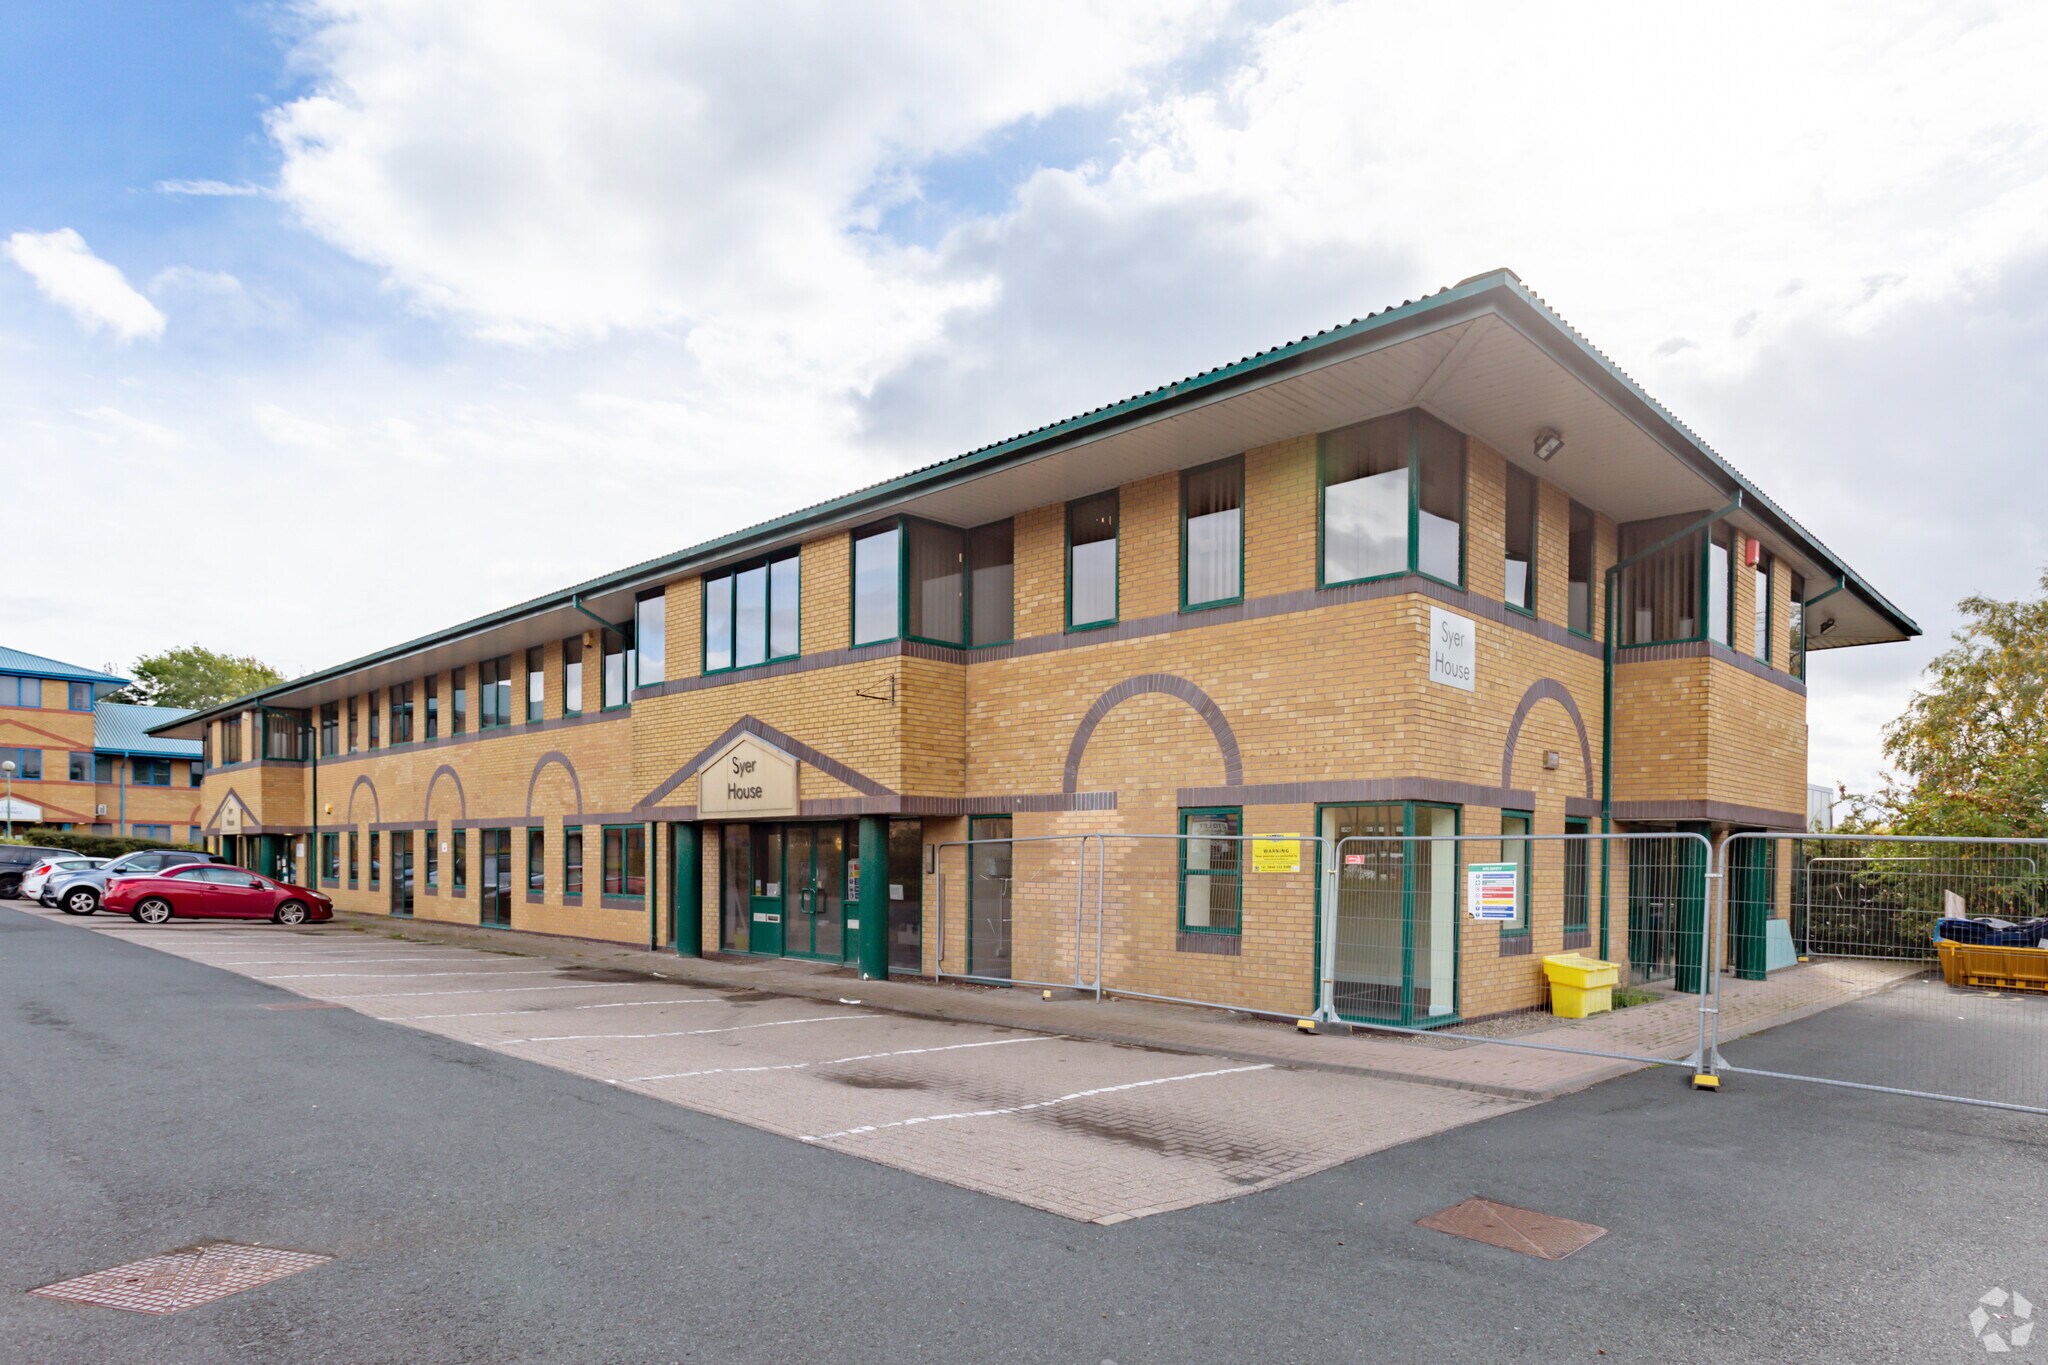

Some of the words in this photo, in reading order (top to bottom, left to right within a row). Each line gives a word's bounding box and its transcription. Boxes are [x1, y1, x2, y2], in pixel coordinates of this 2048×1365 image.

[1441, 620, 1465, 650] Syer
[1435, 650, 1470, 681] House
[732, 756, 757, 778] Syer
[727, 782, 763, 800] House
